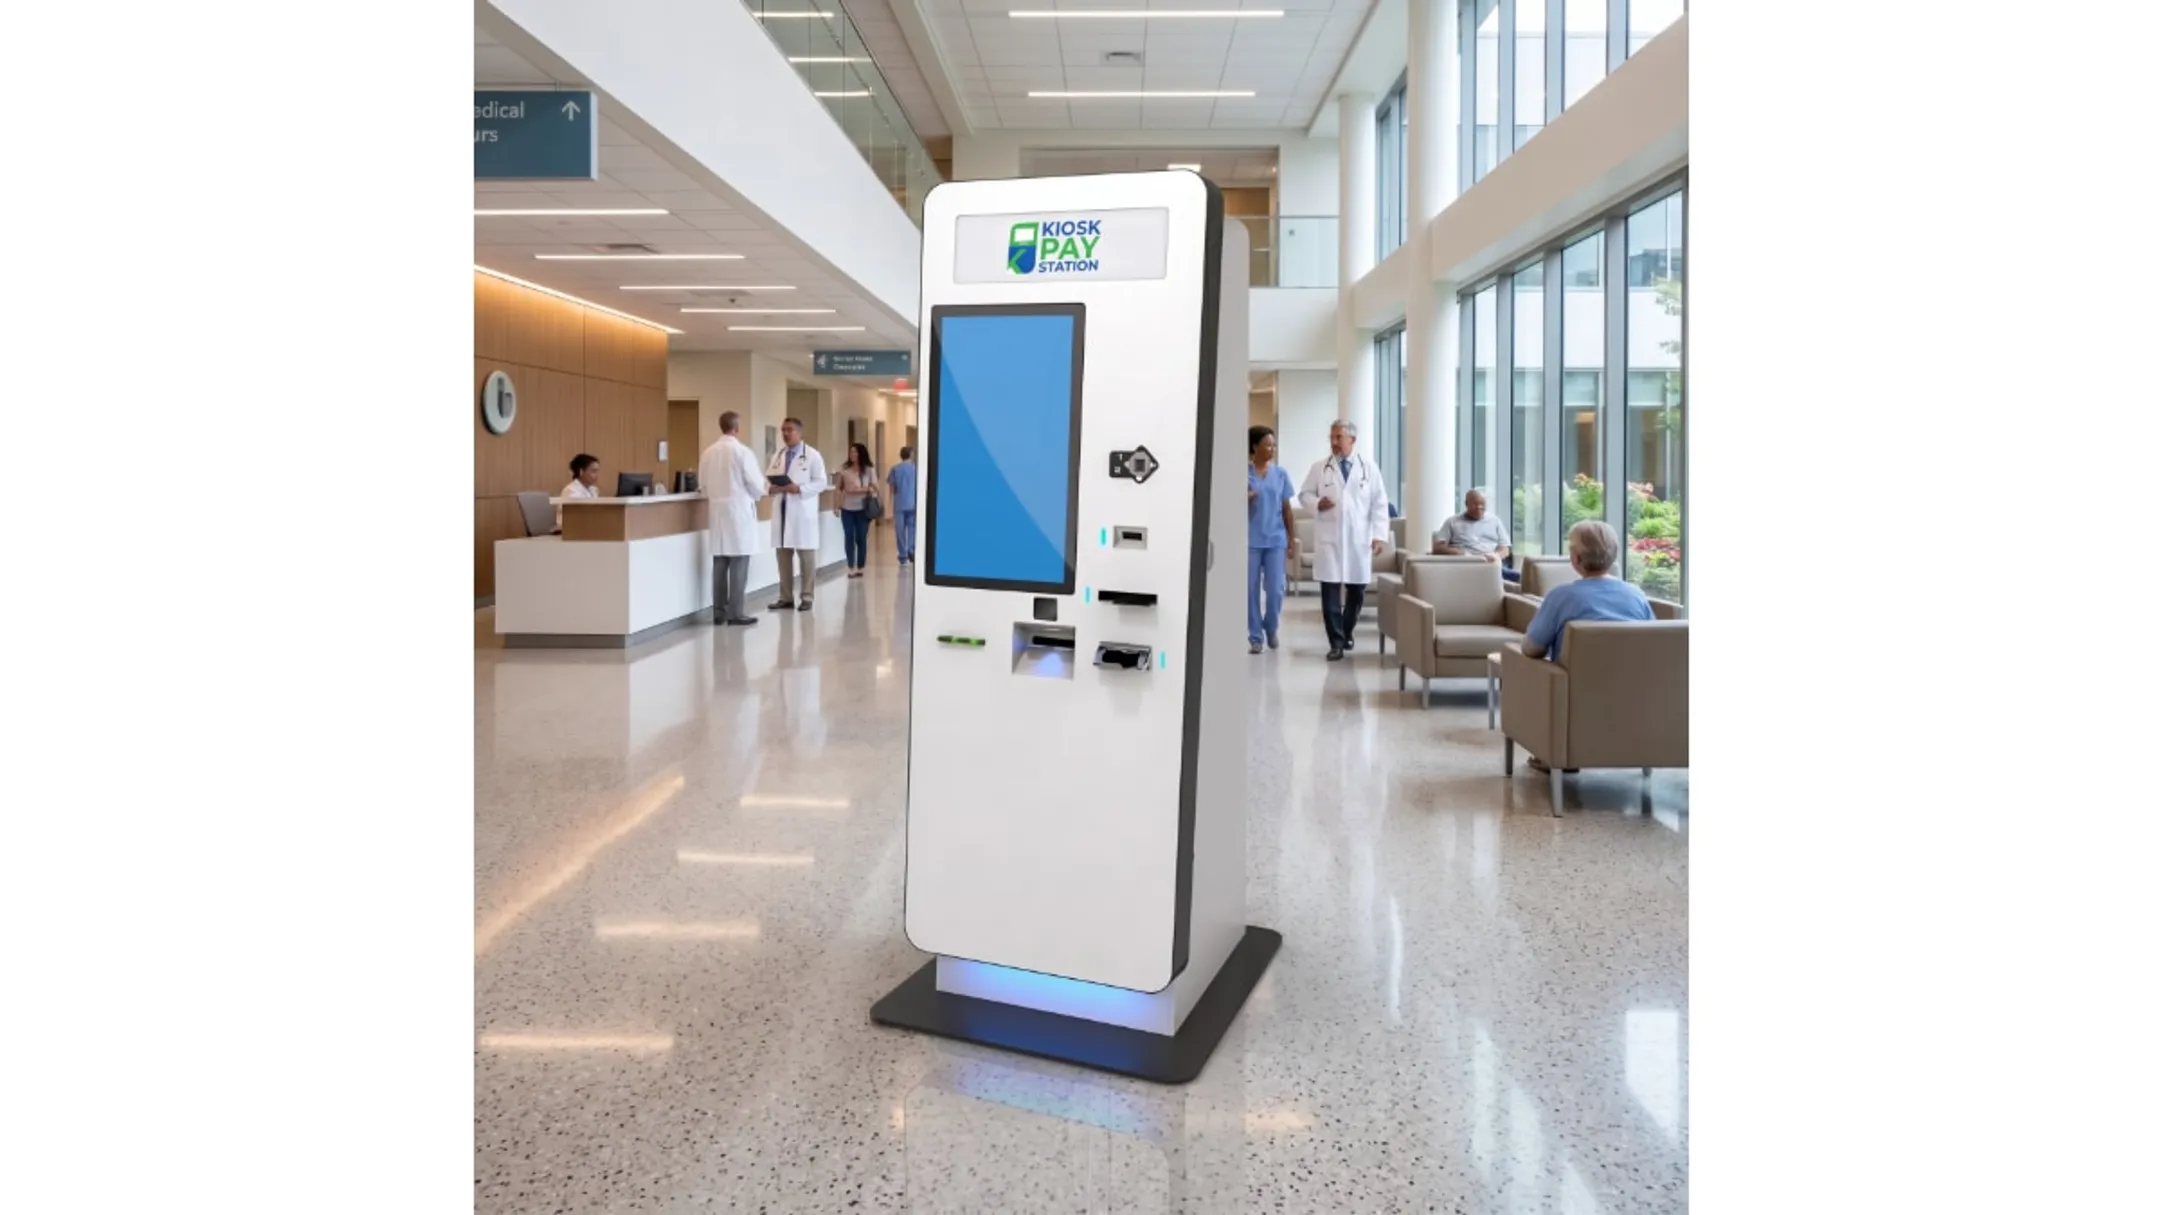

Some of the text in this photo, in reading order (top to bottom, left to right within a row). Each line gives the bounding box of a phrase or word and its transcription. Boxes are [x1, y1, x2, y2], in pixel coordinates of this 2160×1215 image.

[1042, 219, 1102, 237] KIOSK
[1040, 236, 1101, 260] PAY
[1038, 260, 1099, 273] STATION
